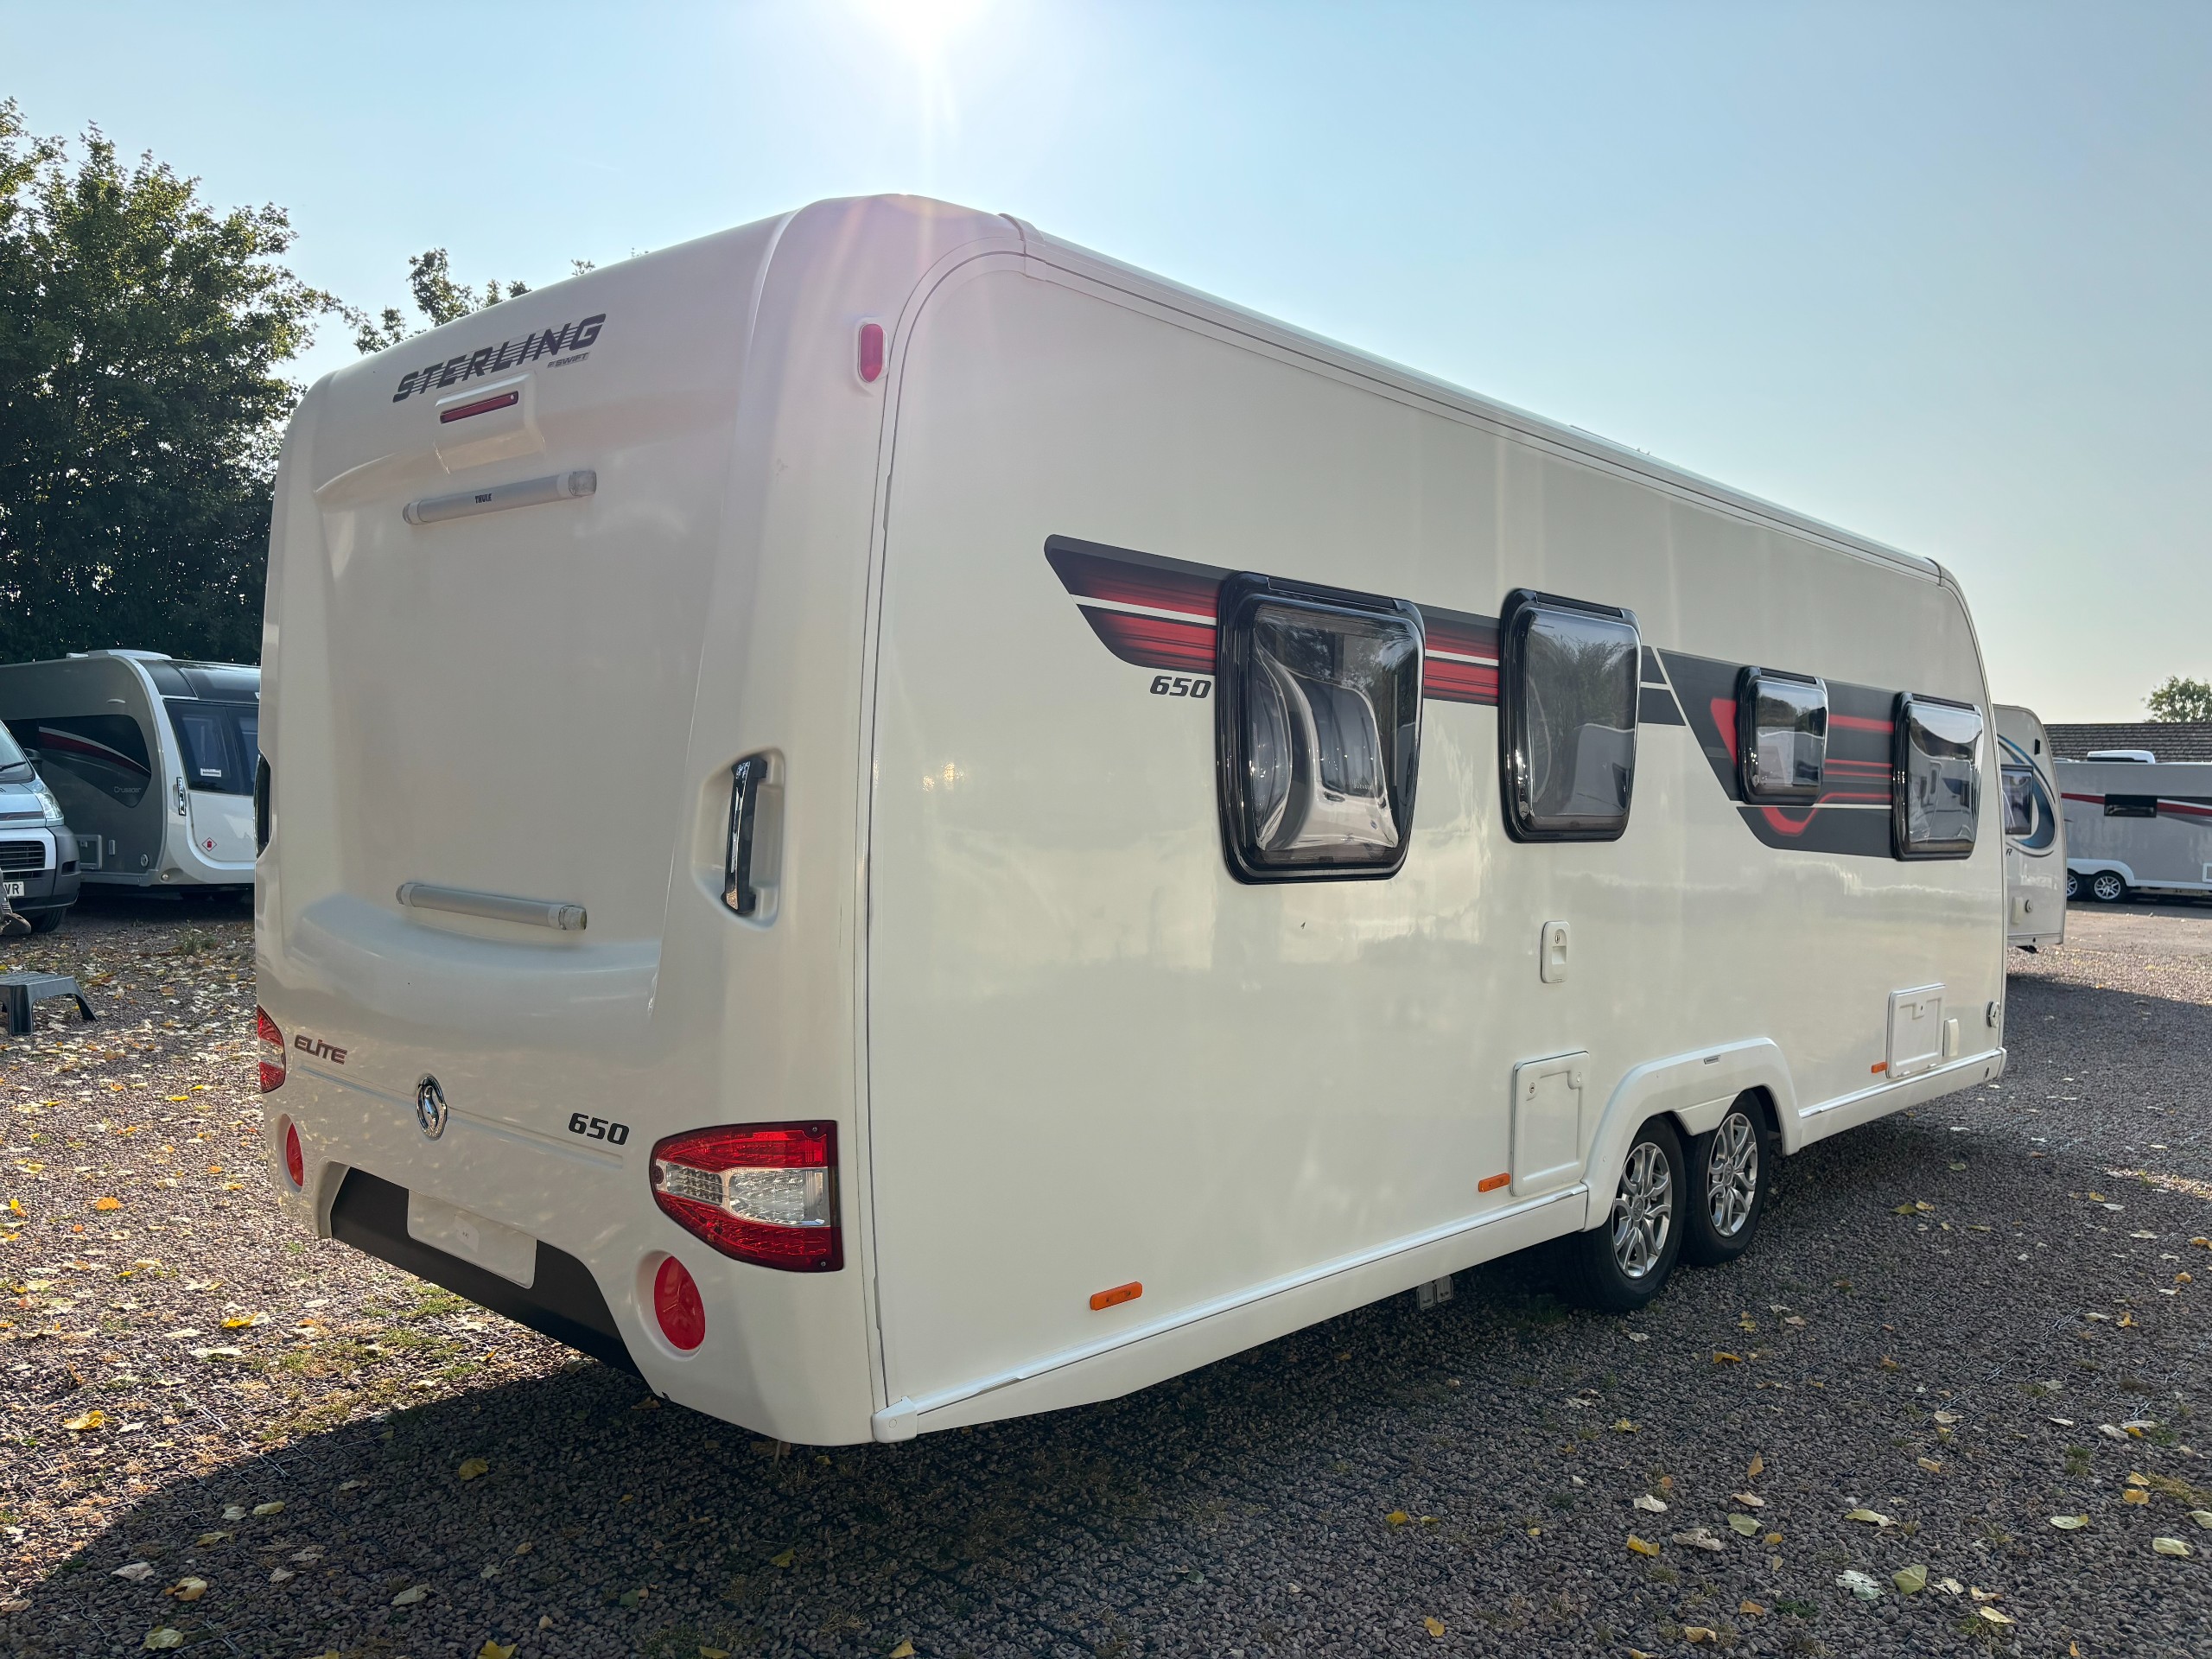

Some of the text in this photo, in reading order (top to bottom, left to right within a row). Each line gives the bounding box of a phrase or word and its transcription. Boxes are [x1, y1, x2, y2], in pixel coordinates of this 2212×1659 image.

[392, 314, 607, 403] STERLING
[555, 352, 589, 366] SWIFT
[474, 493, 493, 504] THULE
[1149, 676, 1212, 698] 650
[568, 1112, 630, 1146] 650
